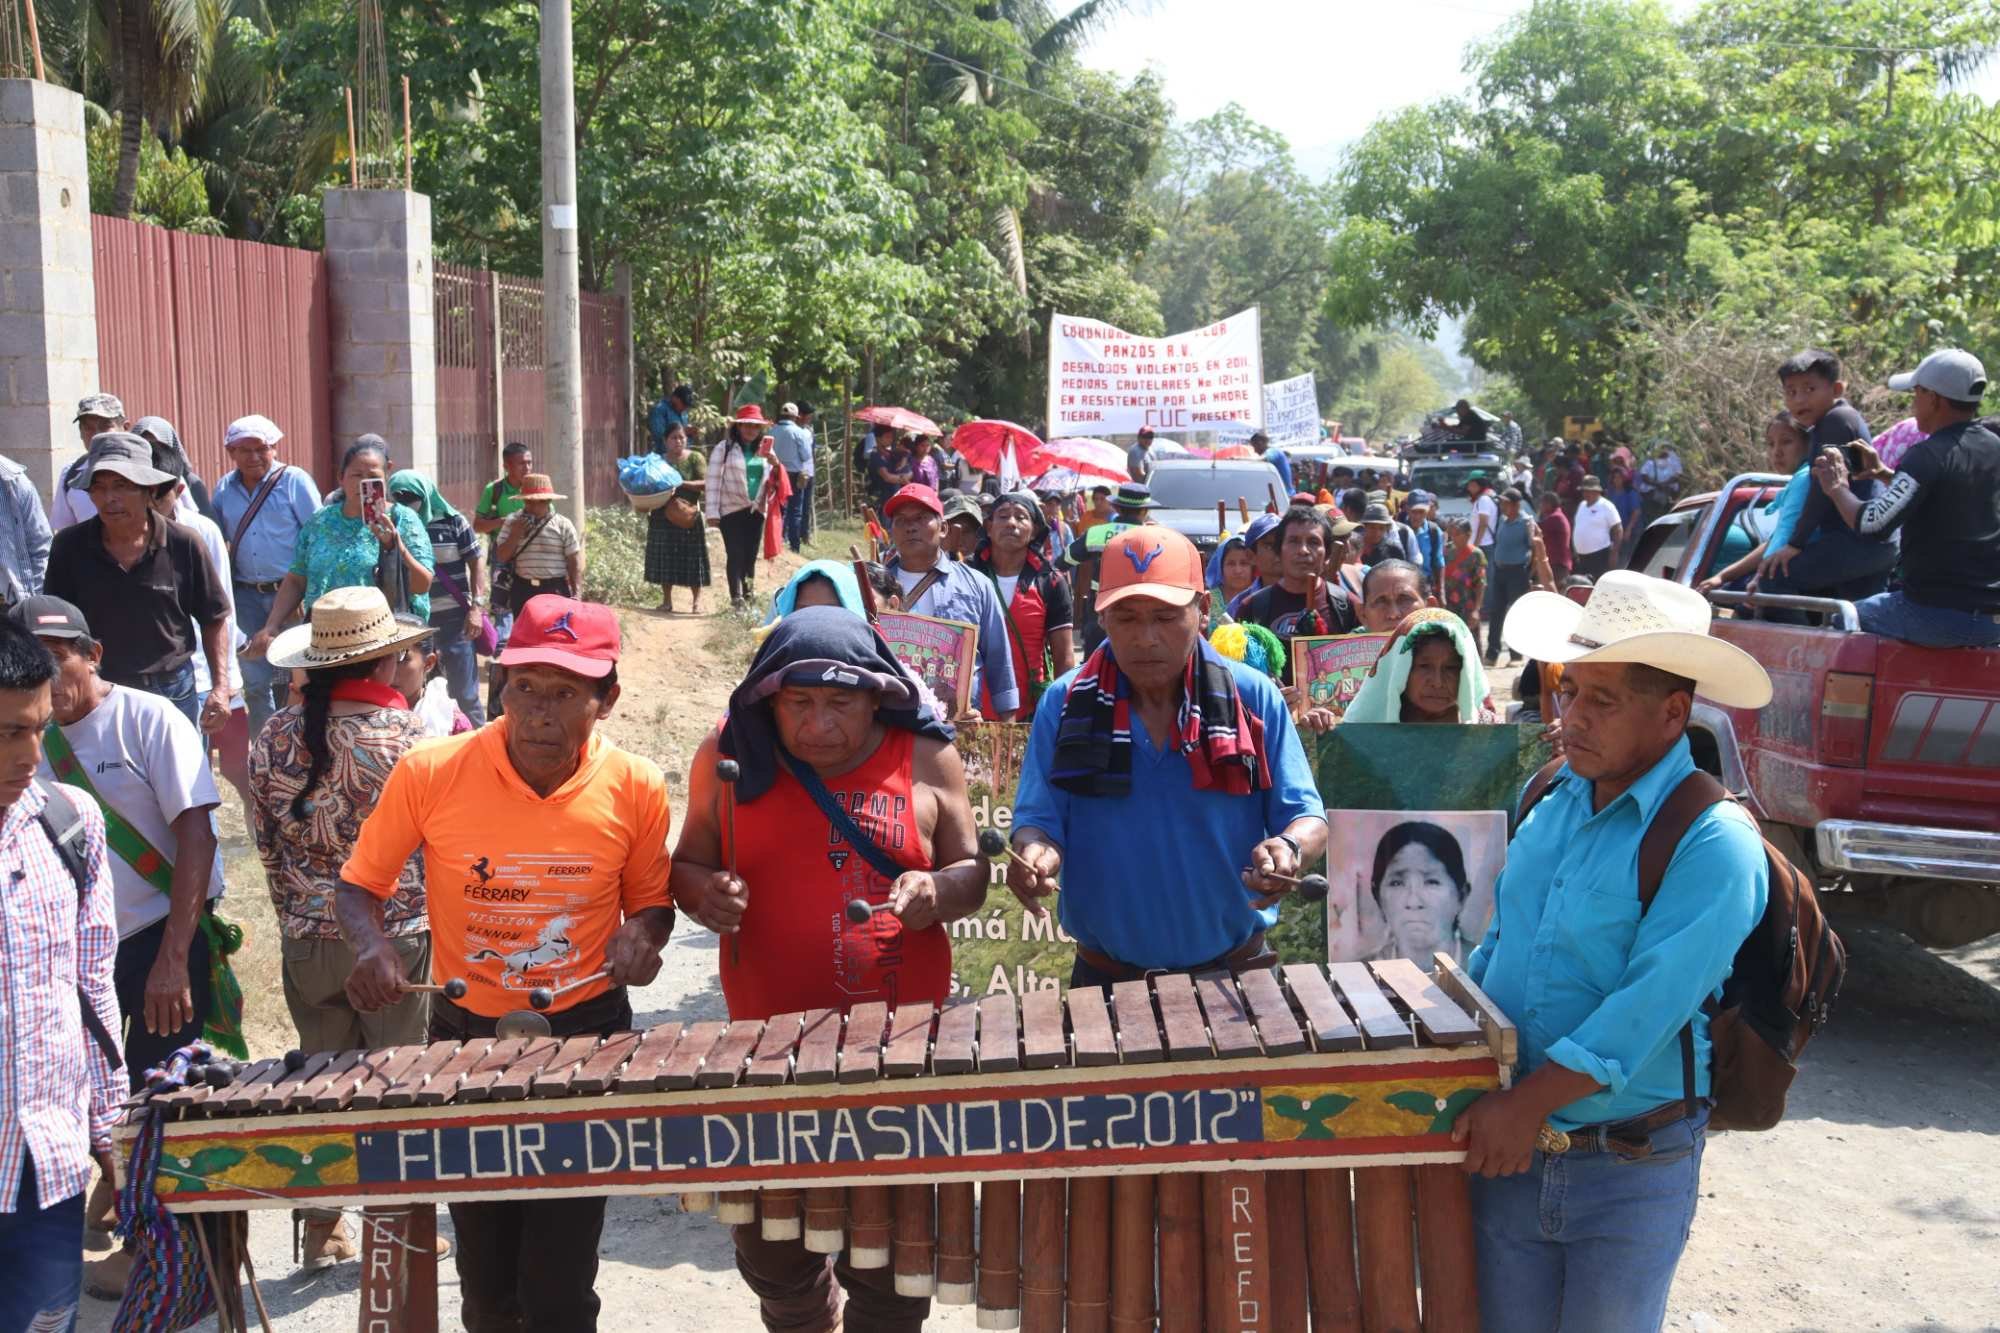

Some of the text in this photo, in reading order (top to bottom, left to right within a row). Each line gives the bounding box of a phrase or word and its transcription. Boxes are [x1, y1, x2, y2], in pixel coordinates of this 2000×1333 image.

[1062, 361, 1128, 374] DESALOJOS
[1136, 362, 1199, 375] VIOLENTOS
[1206, 360, 1220, 371] EN
[1062, 379, 1109, 390] MEDIDAS
[1116, 379, 1191, 391] CAUTELARES
[1219, 373, 1249, 386] 121-11
[1061, 394, 1075, 406] EN
[1081, 395, 1157, 407] RESISTENCIA
[1164, 395, 1185, 407] POR
[1192, 393, 1207, 405] LA
[1213, 389, 1249, 402] MADRE
[1146, 409, 1188, 428] CUC
[1192, 409, 1252, 422] PRESENTE
[973, 796, 1013, 828] de
[547, 865, 594, 876] FERRARY
[463, 884, 531, 903] FERRARY
[468, 911, 537, 927] MISSION
[945, 908, 1006, 941] má
[1232, 1186, 1259, 1333] REFO
